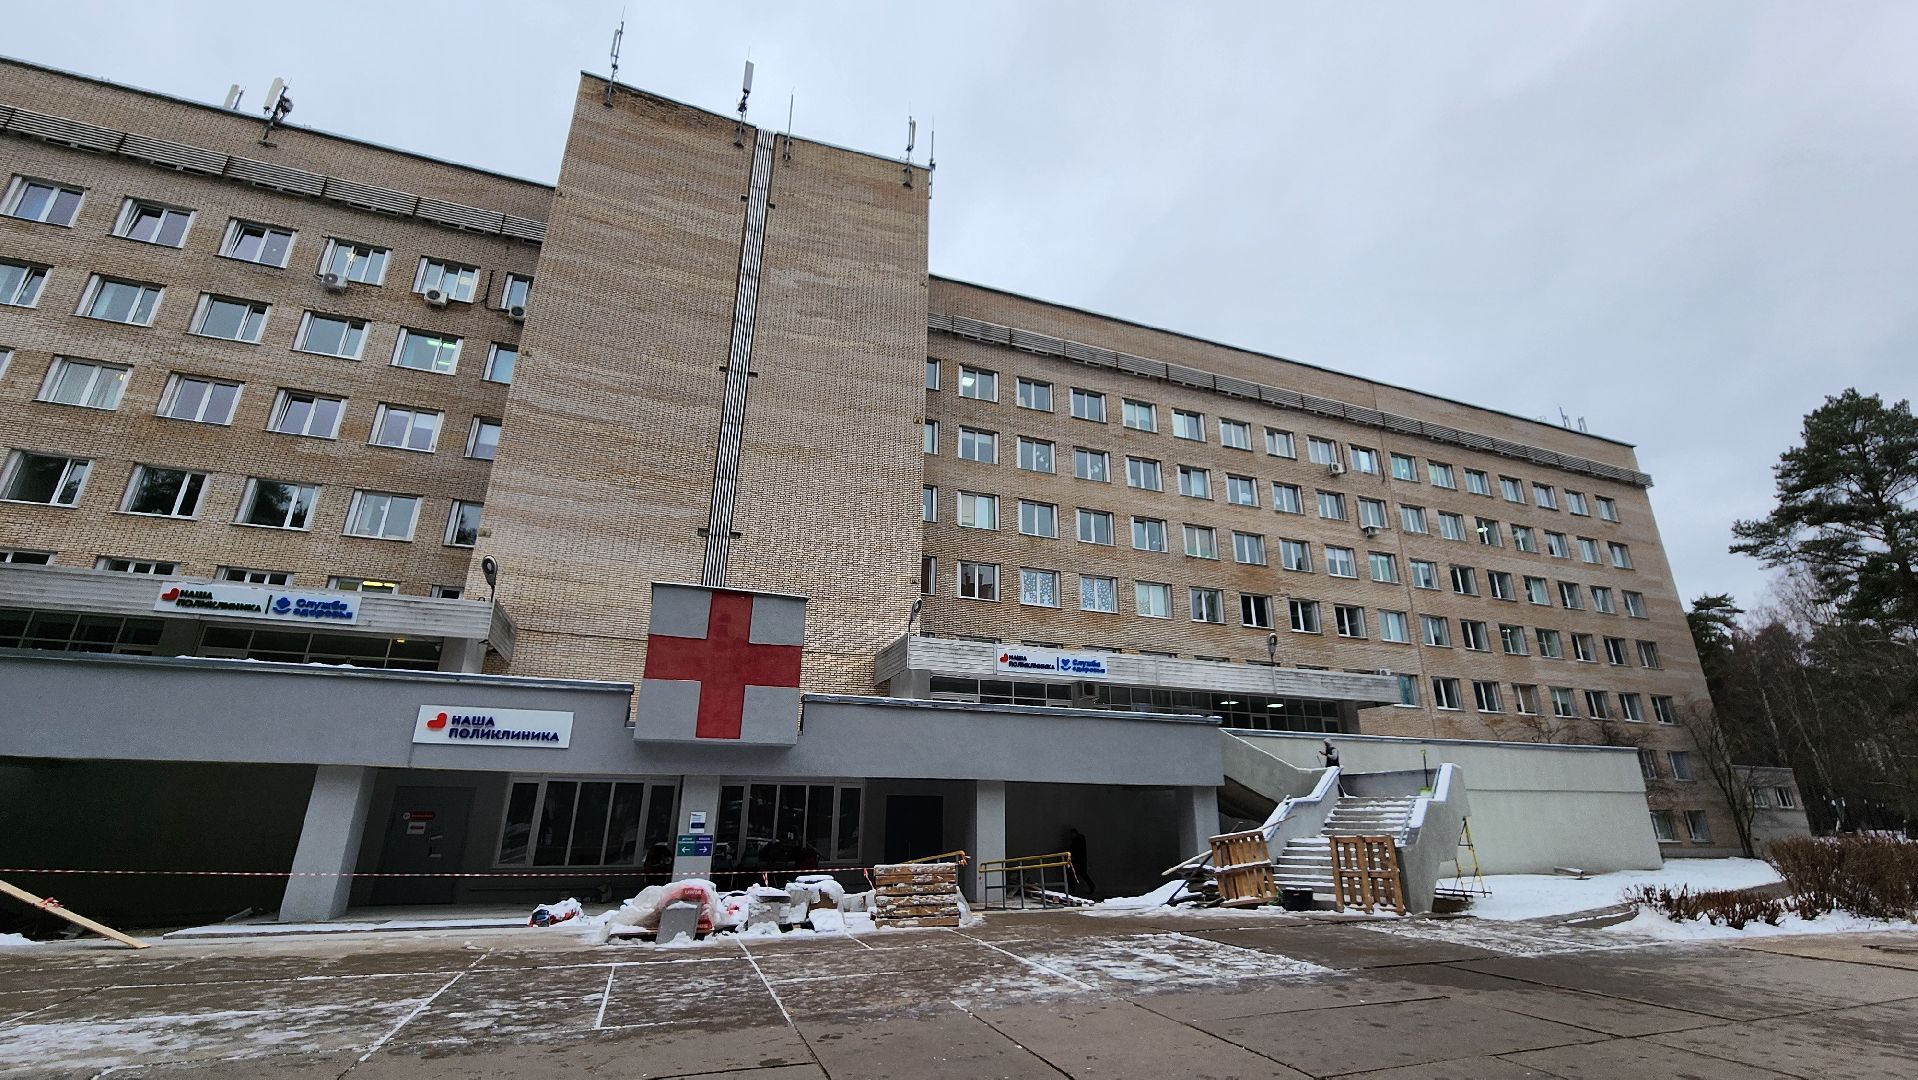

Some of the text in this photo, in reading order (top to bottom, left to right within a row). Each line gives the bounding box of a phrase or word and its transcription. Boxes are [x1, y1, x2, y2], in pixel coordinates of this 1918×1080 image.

[180, 589, 213, 599] НАША
[176, 599, 261, 612] ПОЛИКЛИНИКА
[296, 599, 347, 610] Служба
[451, 715, 495, 727] НАША
[449, 727, 560, 742] ПОЛИКЛИНИКА
